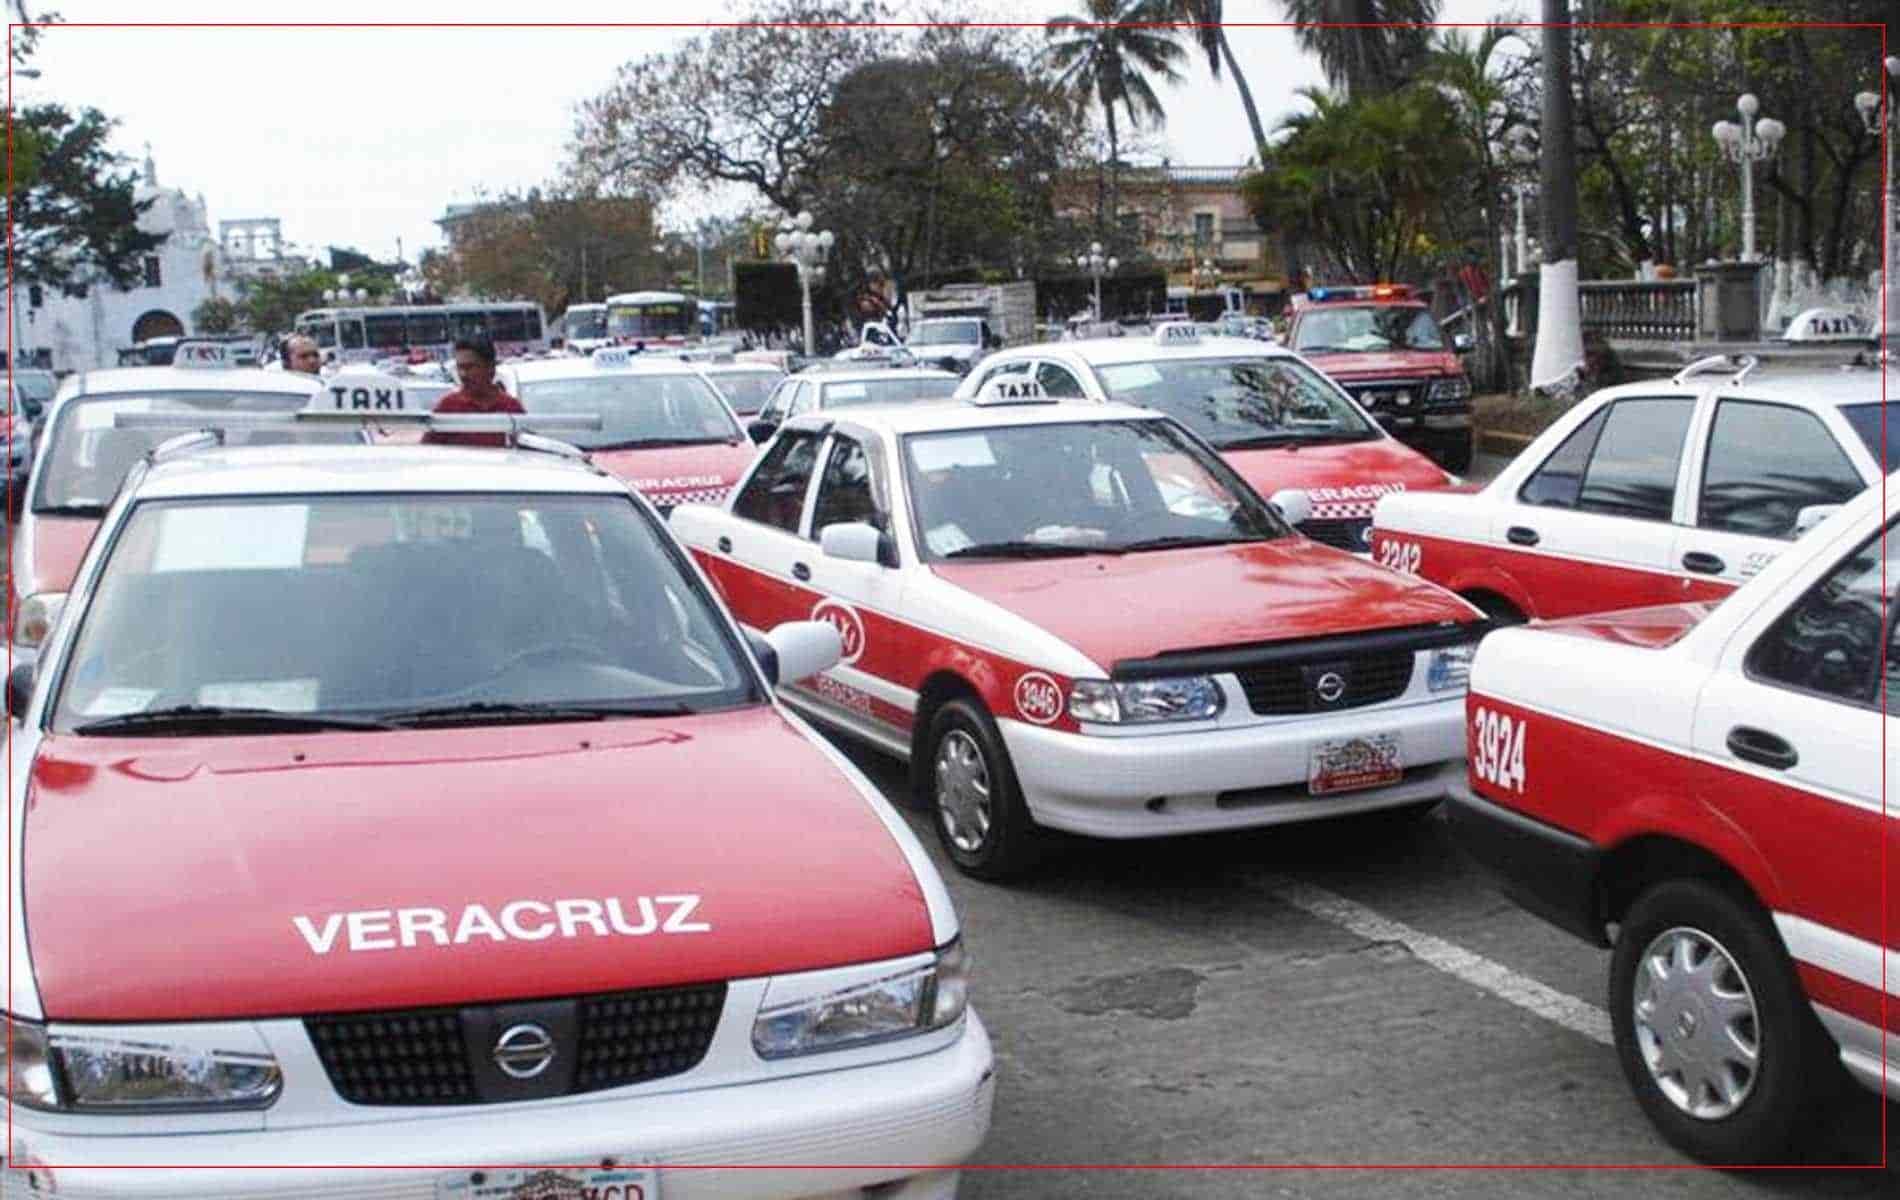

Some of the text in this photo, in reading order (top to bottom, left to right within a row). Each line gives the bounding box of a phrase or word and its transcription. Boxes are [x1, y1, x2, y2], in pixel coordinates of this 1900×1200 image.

[1809, 318, 1848, 334] TAXI
[330, 387, 404, 409] TAXI
[998, 383, 1039, 397] TAXI
[1022, 681, 1055, 715] 3946
[1474, 705, 1526, 795] 3924
[293, 894, 711, 955] VERACRUZ
